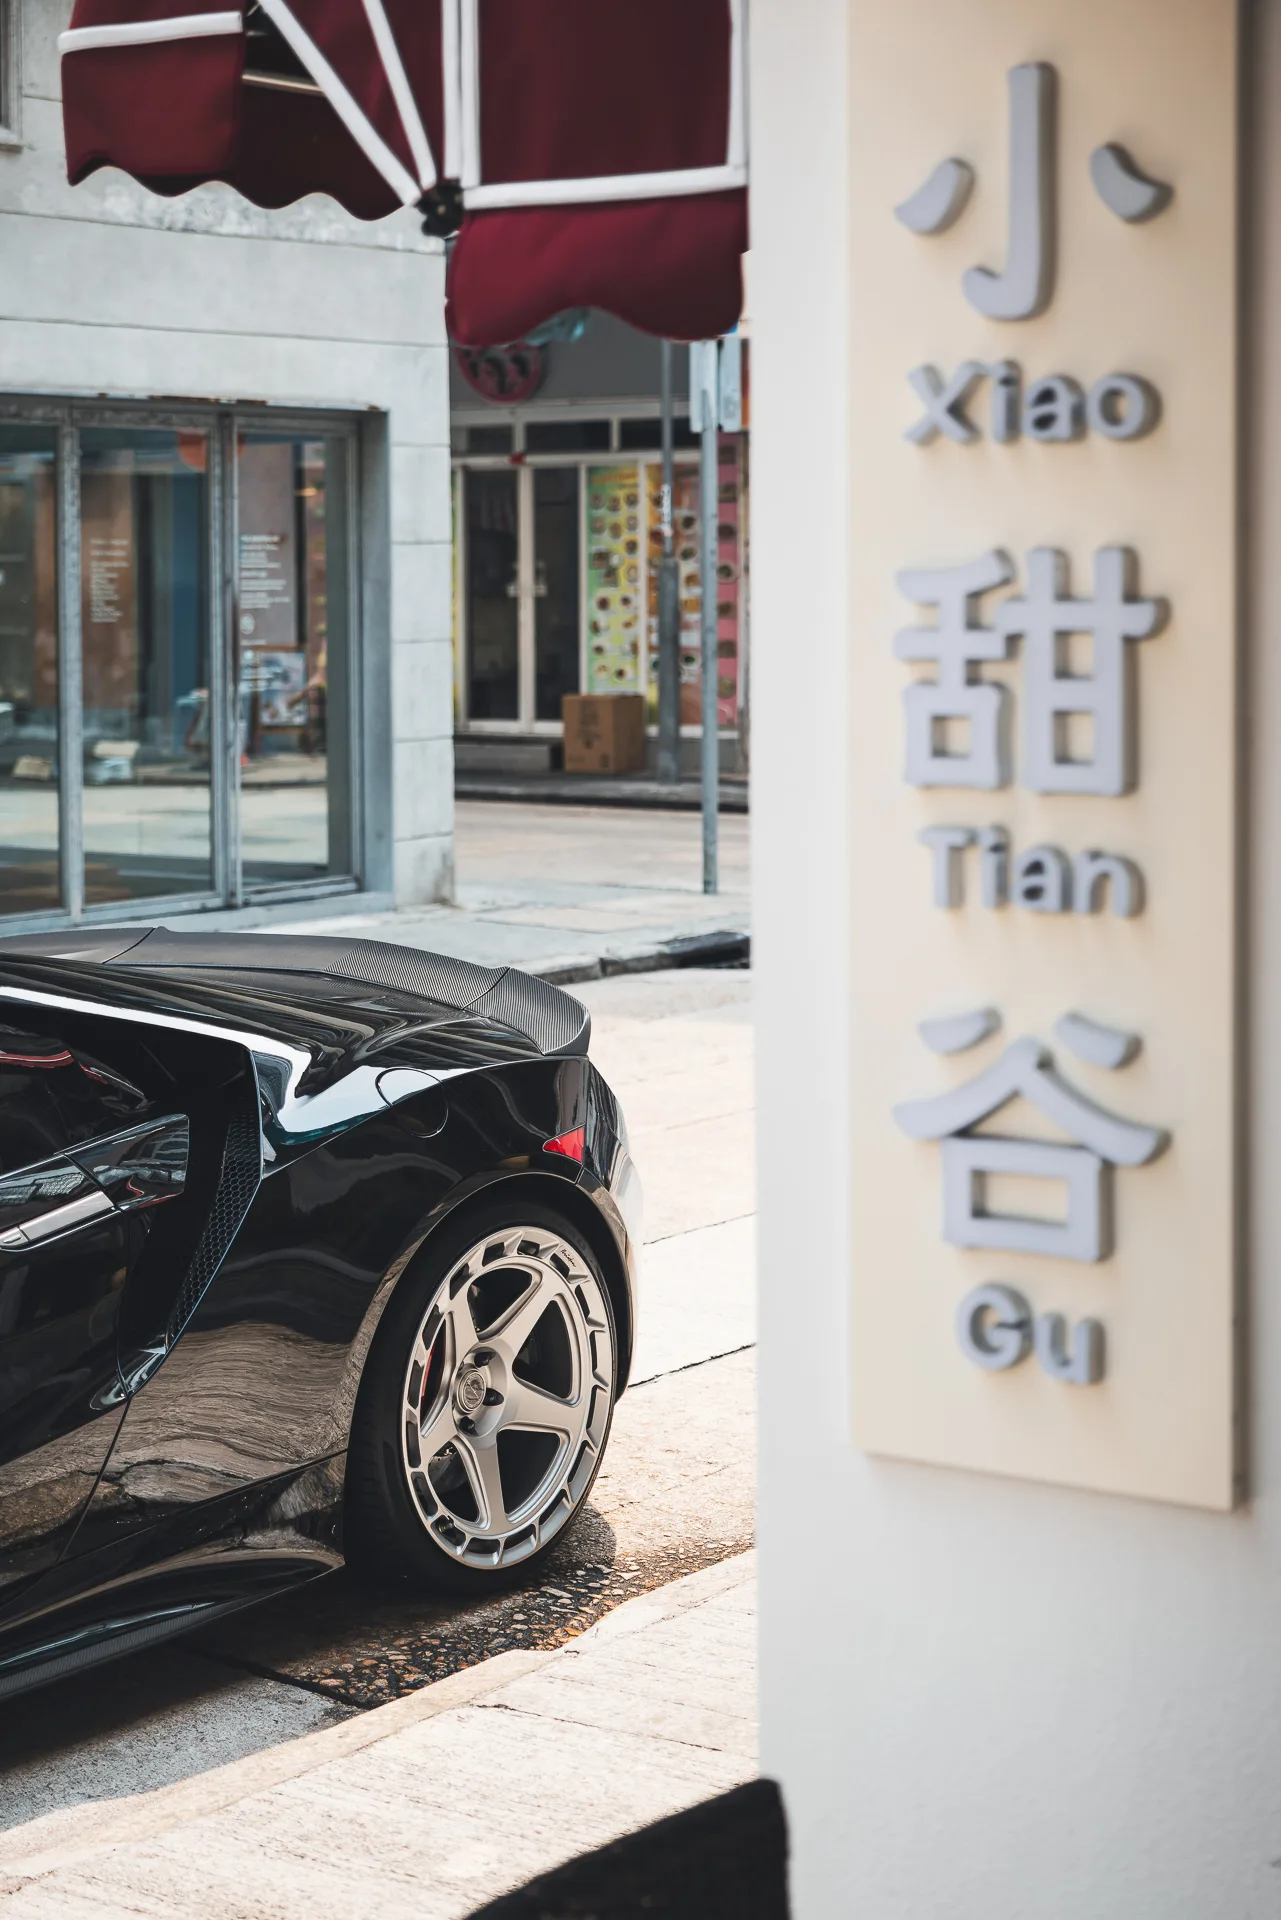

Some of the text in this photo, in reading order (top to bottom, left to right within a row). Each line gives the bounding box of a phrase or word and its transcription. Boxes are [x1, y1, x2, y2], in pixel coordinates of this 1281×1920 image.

[894, 61, 1175, 322] 小
[903, 359, 1162, 446] Xiao
[894, 545, 1172, 797] 甜
[917, 824, 1146, 918] Tian
[892, 1006, 1173, 1264] 谷
[955, 1282, 1107, 1386] Gu
